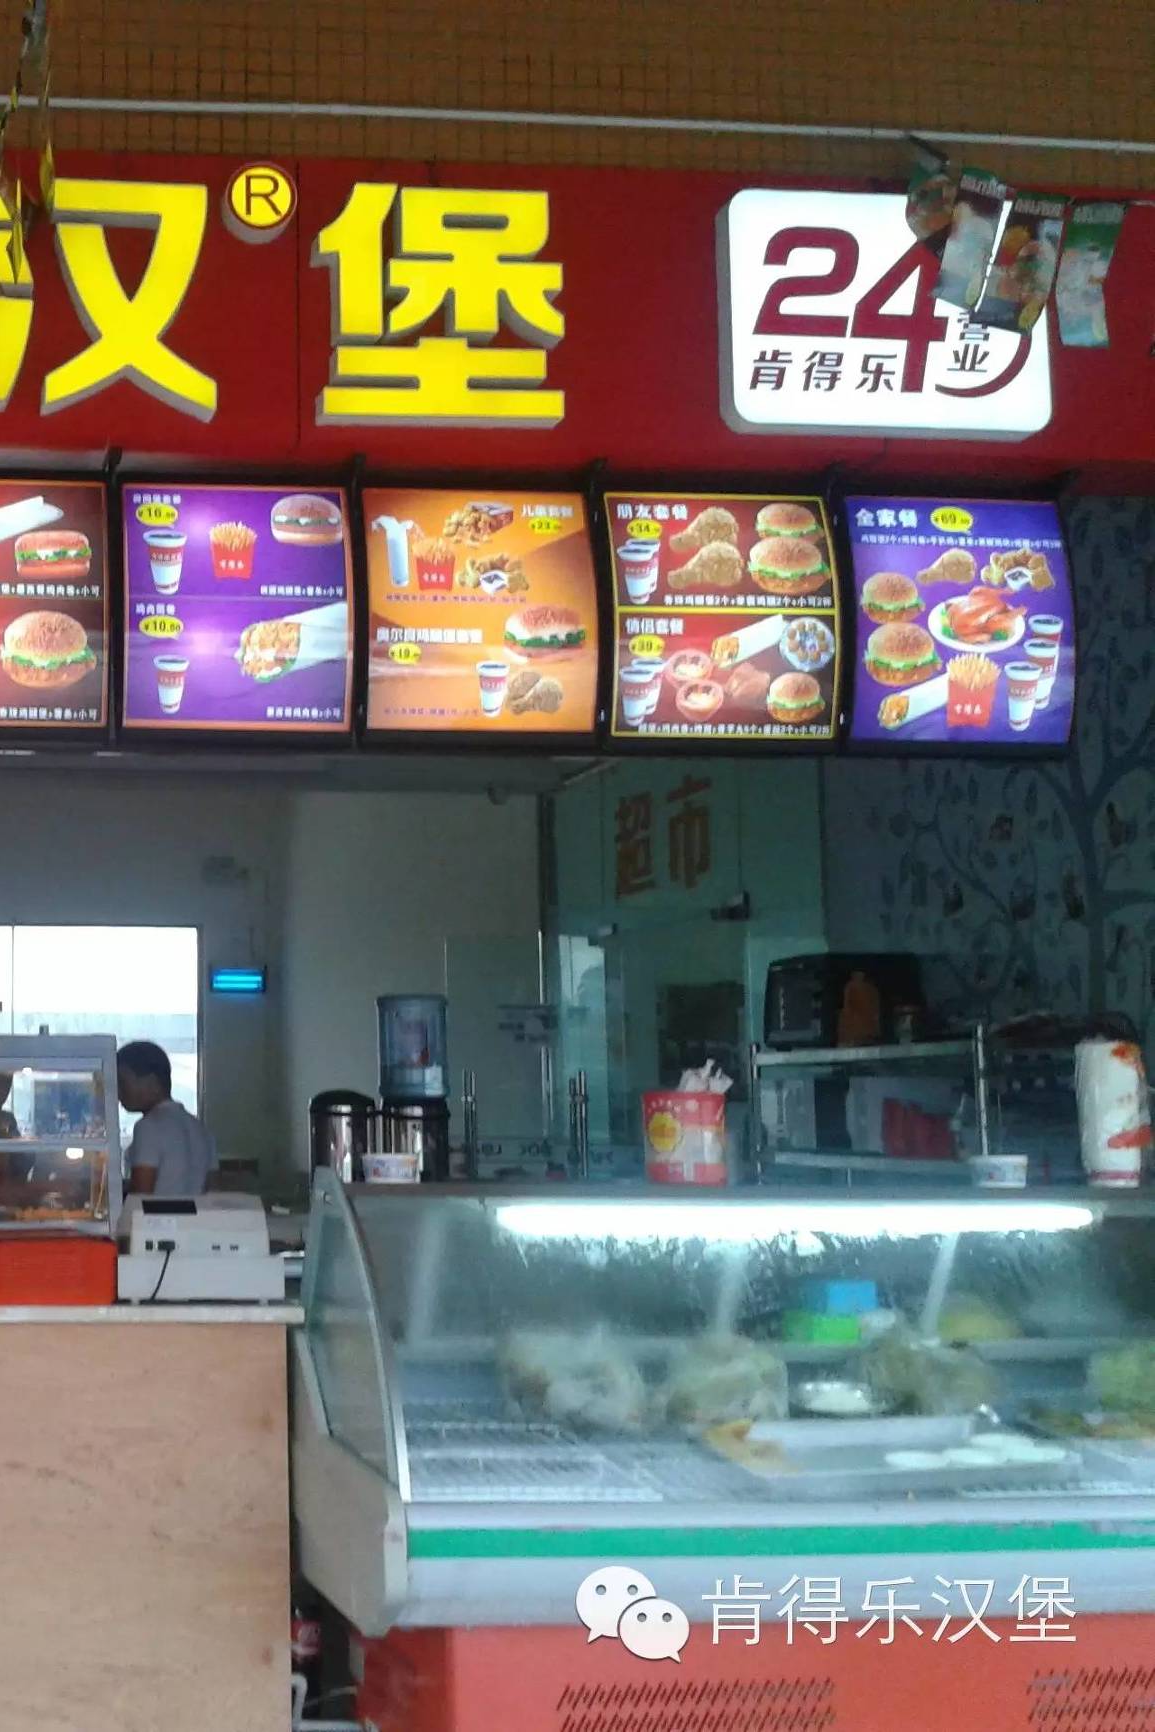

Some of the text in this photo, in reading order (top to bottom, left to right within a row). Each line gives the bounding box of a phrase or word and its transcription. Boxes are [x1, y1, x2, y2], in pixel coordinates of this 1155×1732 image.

[749, 350, 898, 393] 肯得乐
[752, 227, 948, 393] 24
[614, 774, 713, 898] 超市
